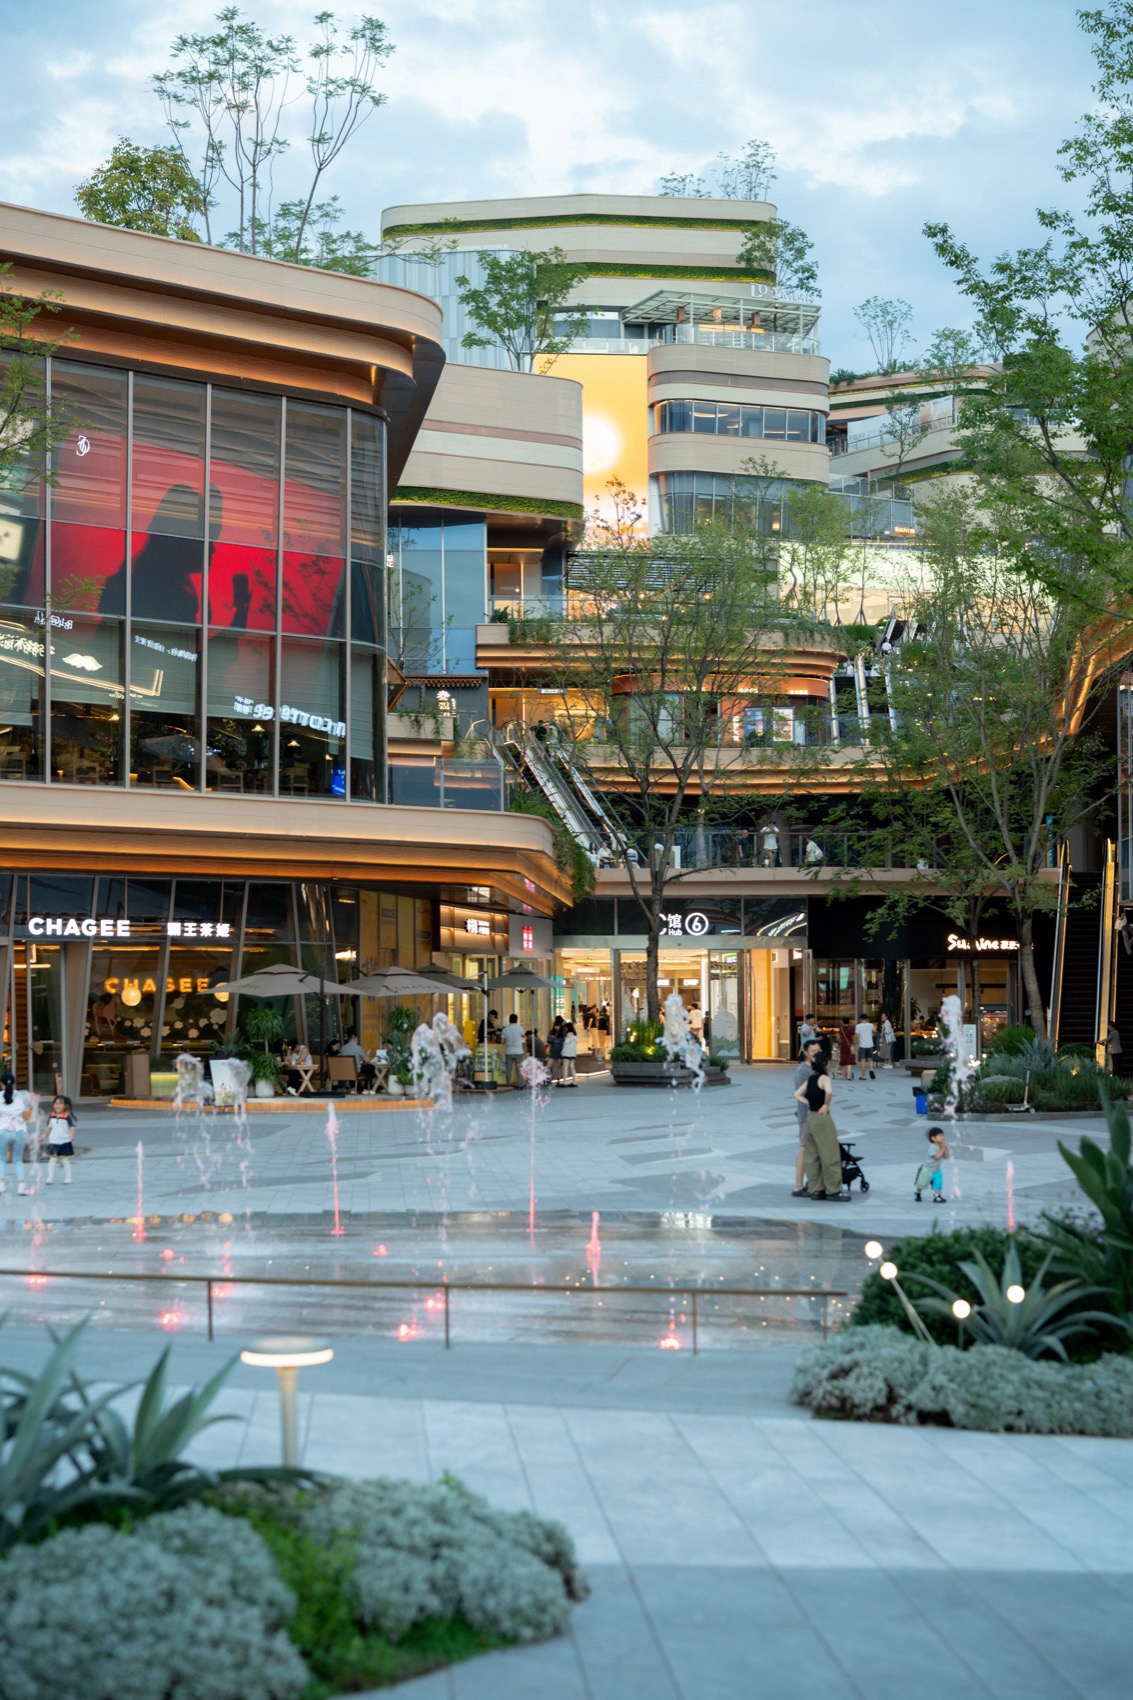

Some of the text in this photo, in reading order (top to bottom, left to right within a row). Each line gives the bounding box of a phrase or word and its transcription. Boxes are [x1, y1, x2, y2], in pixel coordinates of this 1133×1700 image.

[28, 917, 131, 937] CHAGEE
[668, 928, 682, 936] Hub
[104, 977, 208, 994] CHAGEE
